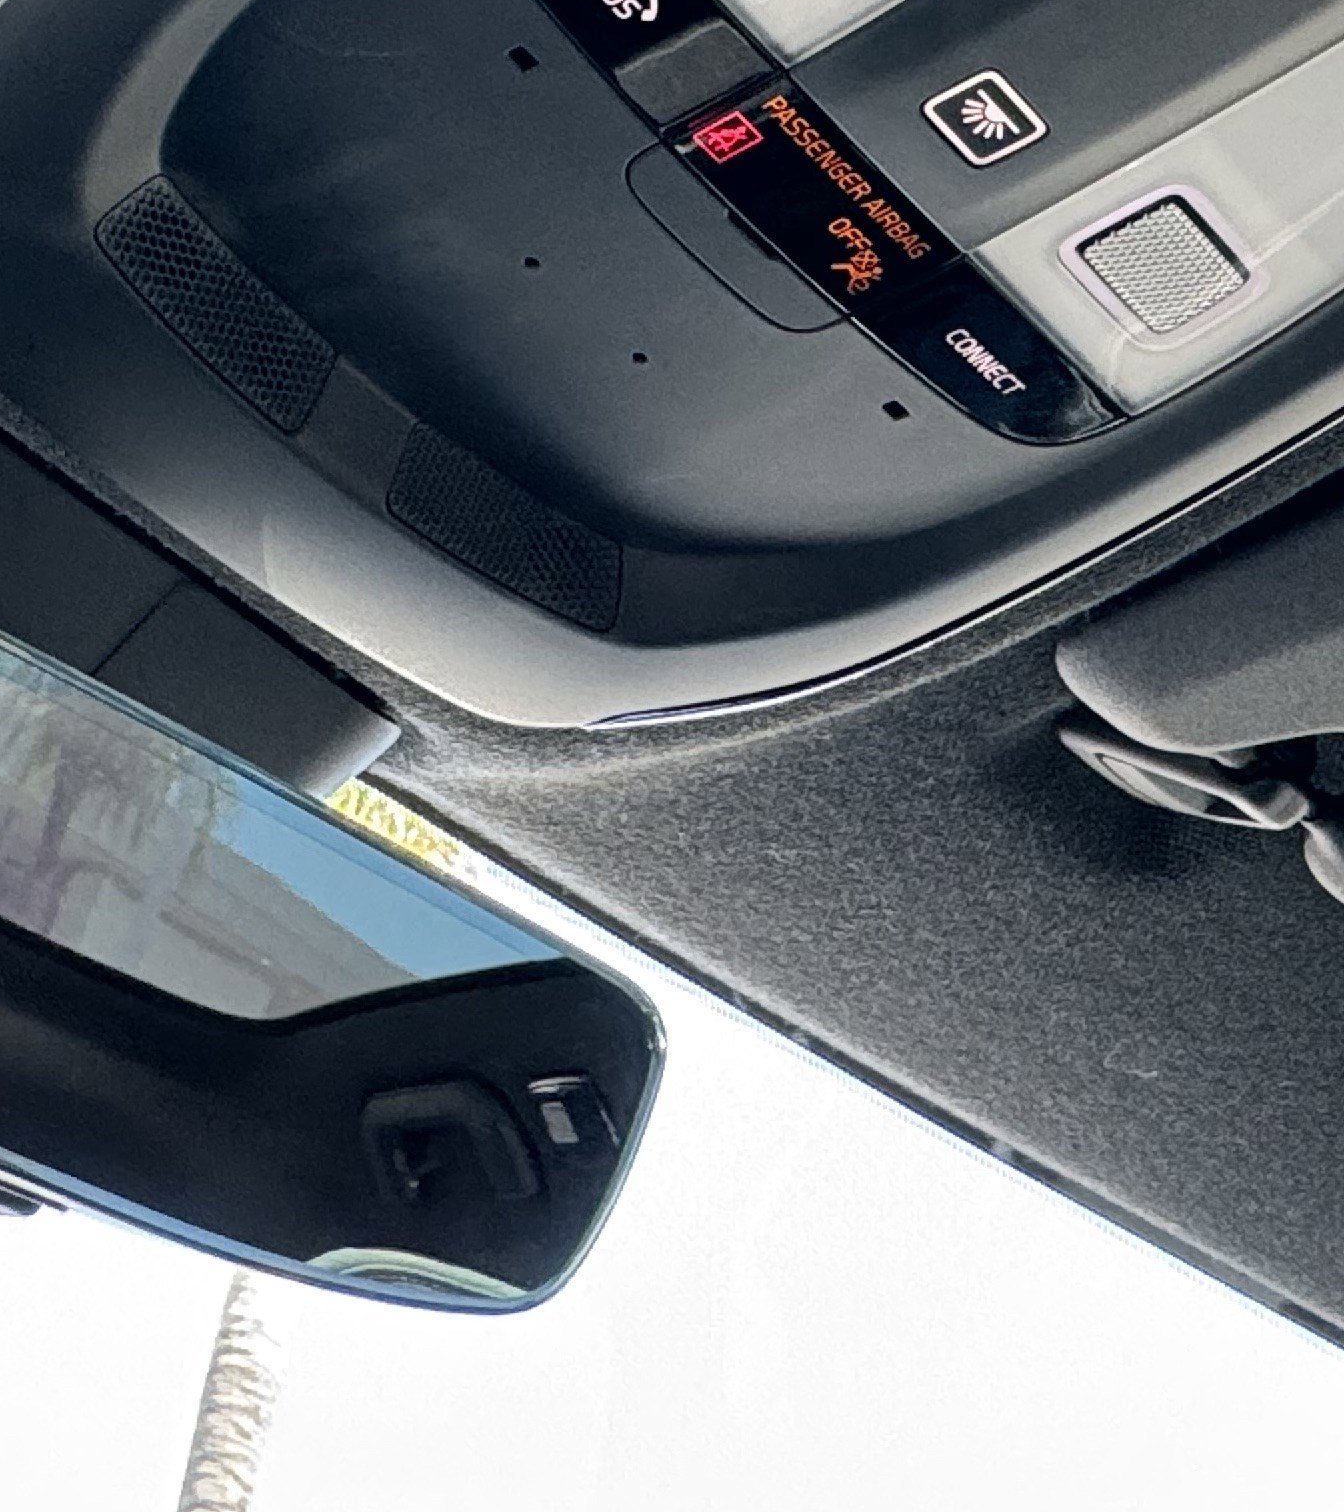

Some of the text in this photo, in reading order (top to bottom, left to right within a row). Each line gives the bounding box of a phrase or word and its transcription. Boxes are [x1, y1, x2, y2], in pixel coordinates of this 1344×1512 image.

[761, 94, 932, 260] PASSENGER AIRBAG
[828, 217, 873, 251] OFF
[944, 327, 1027, 396] CONNECT
